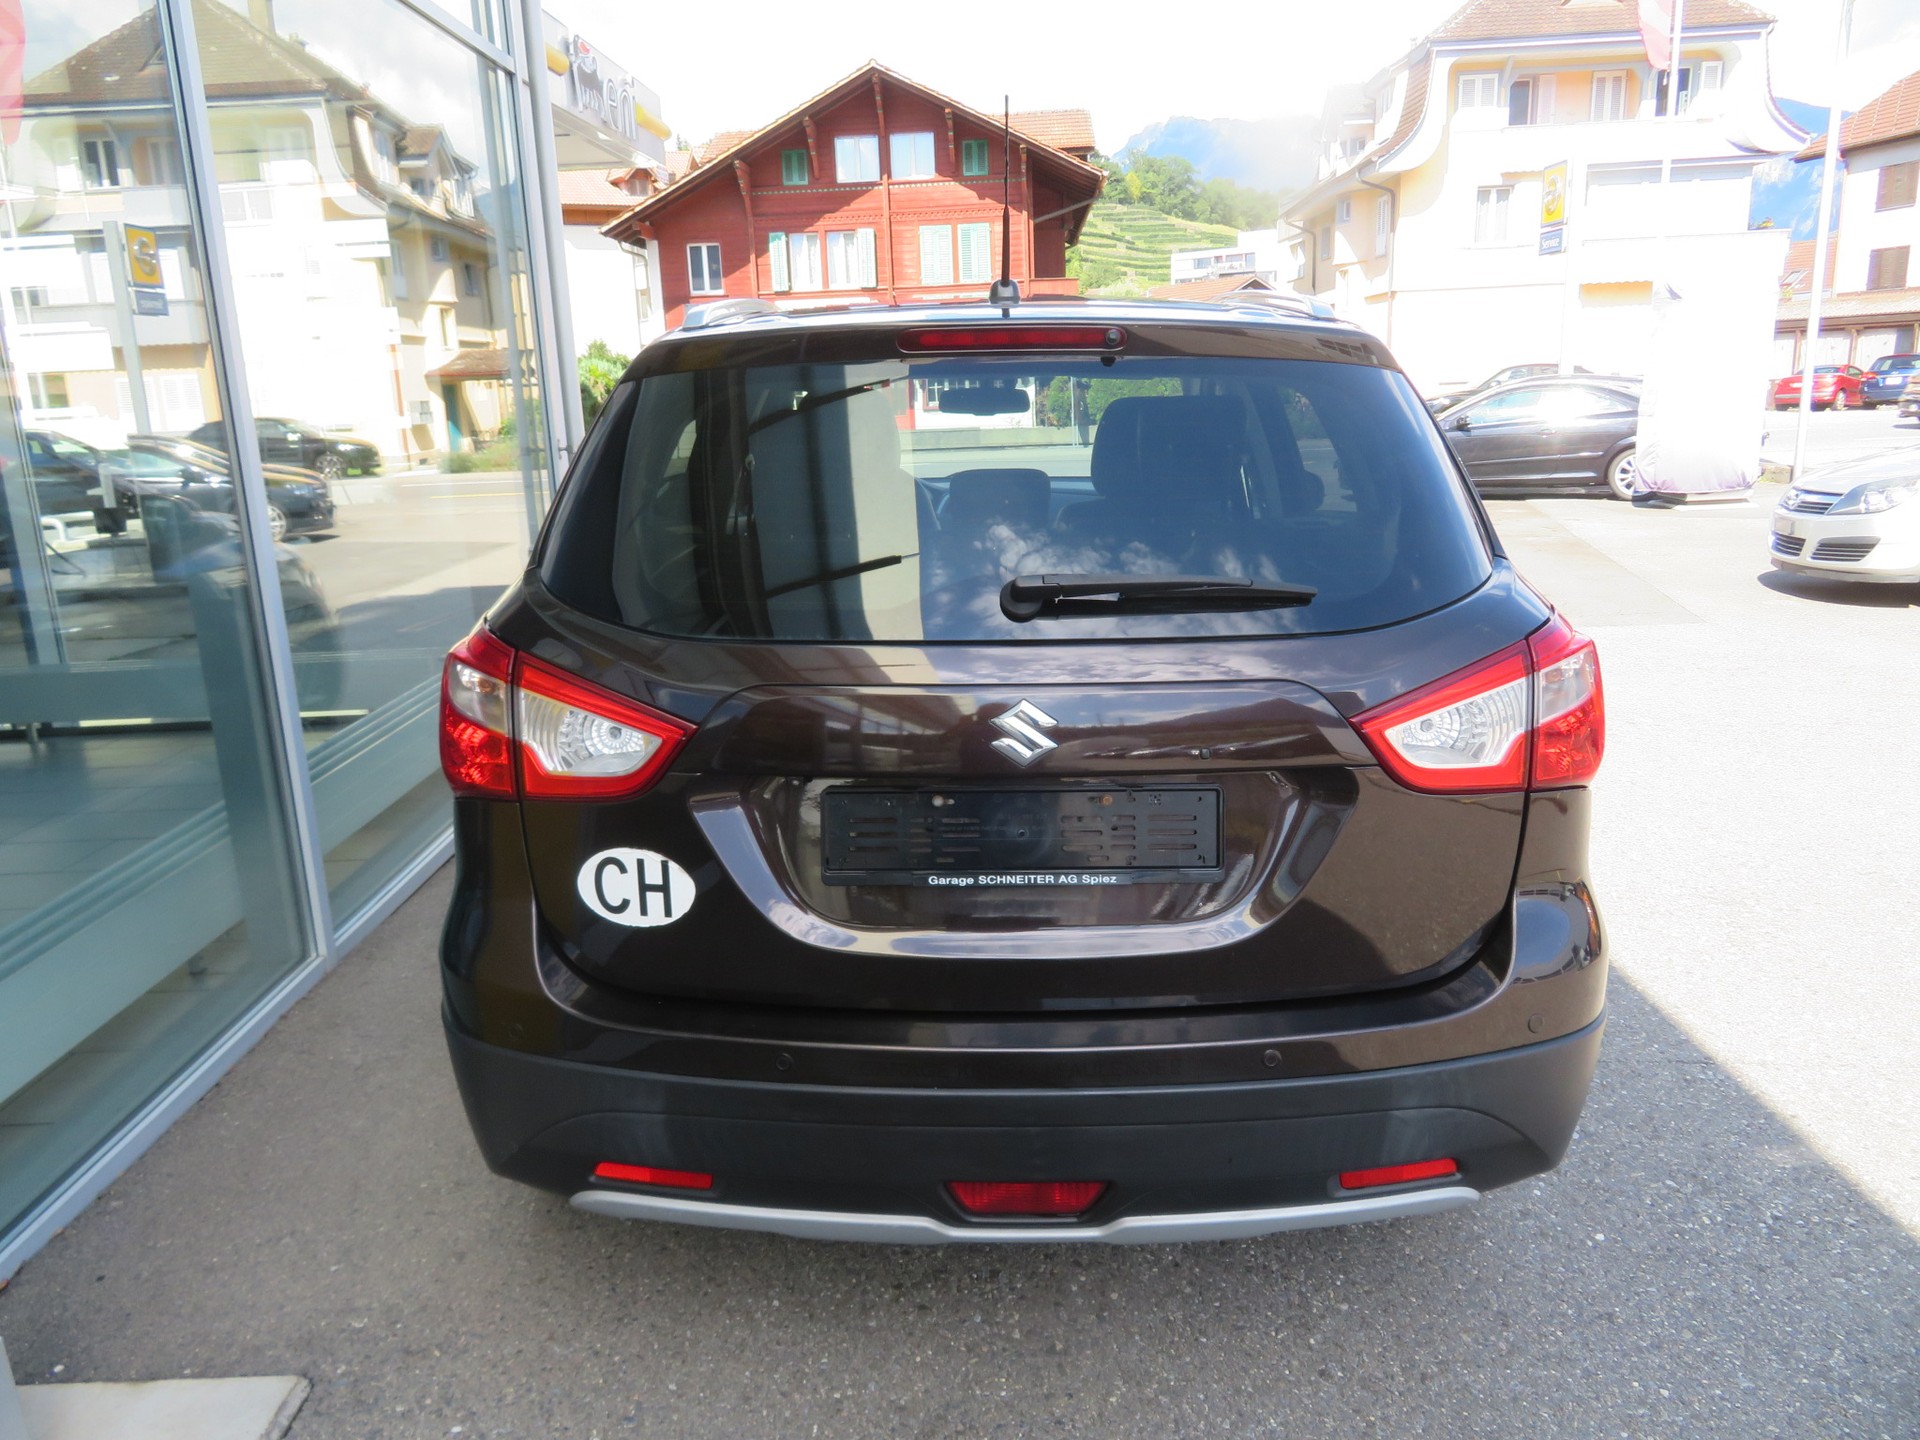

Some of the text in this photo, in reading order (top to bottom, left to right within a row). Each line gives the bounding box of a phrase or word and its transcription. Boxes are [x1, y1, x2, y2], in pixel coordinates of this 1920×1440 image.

[594, 856, 672, 918] CH
[928, 874, 1117, 887] Garage SCHNEITER AG Spiez
